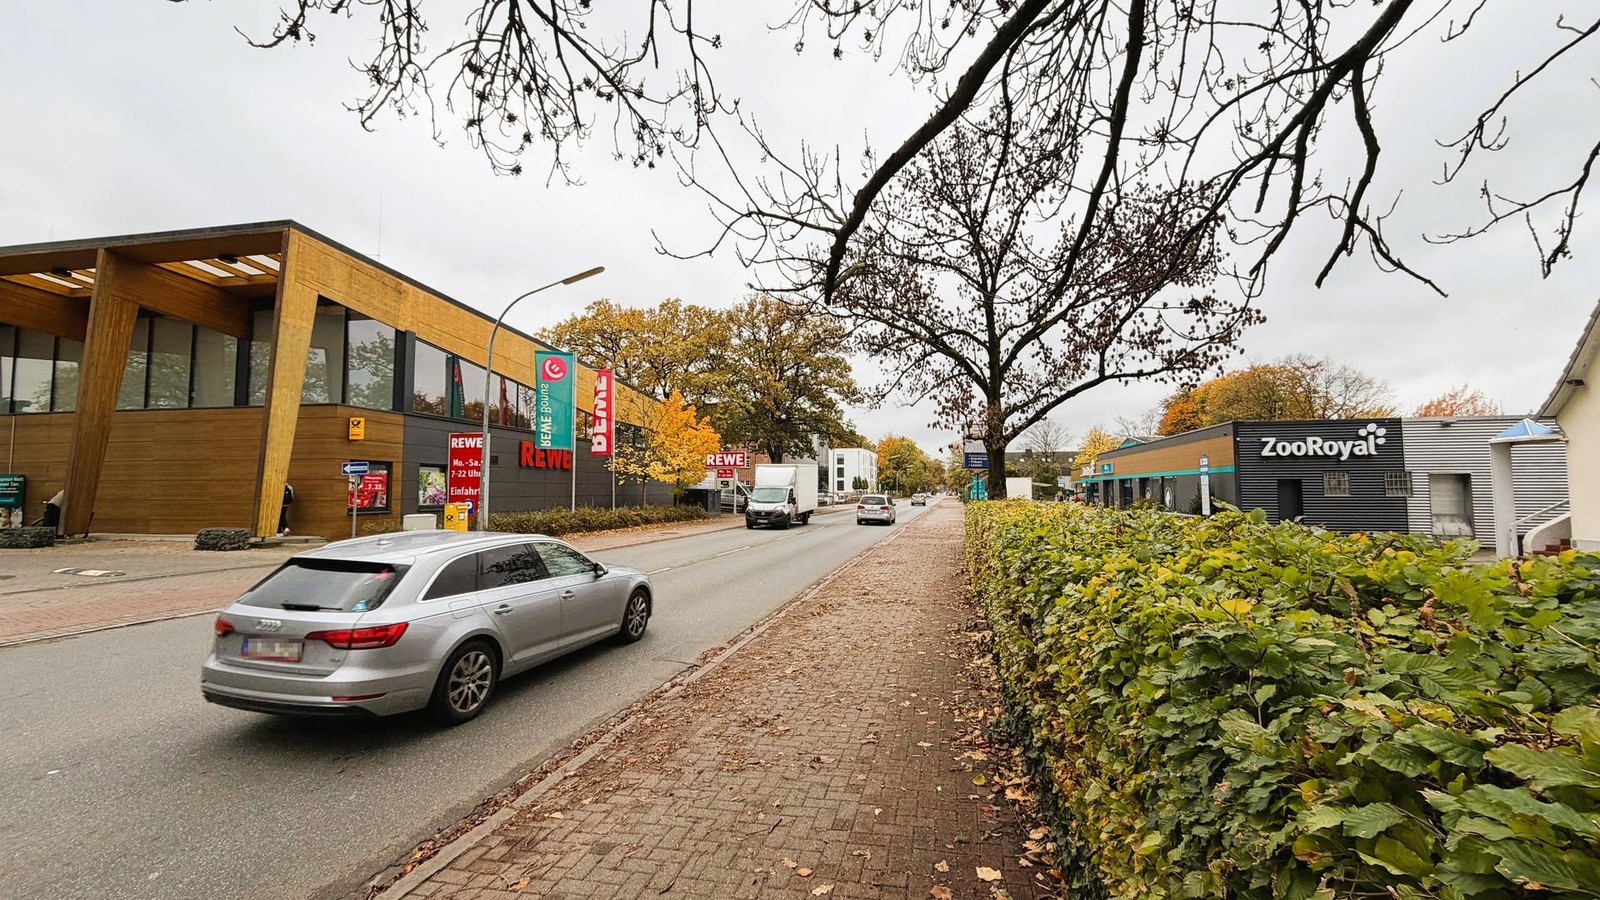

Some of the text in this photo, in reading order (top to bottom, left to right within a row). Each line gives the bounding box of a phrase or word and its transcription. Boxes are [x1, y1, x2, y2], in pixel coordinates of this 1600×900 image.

[451, 437, 483, 449] REWE
[1260, 434, 1378, 461] ZooRoyal
[520, 440, 572, 470] REWE
[706, 453, 744, 466] REWE
